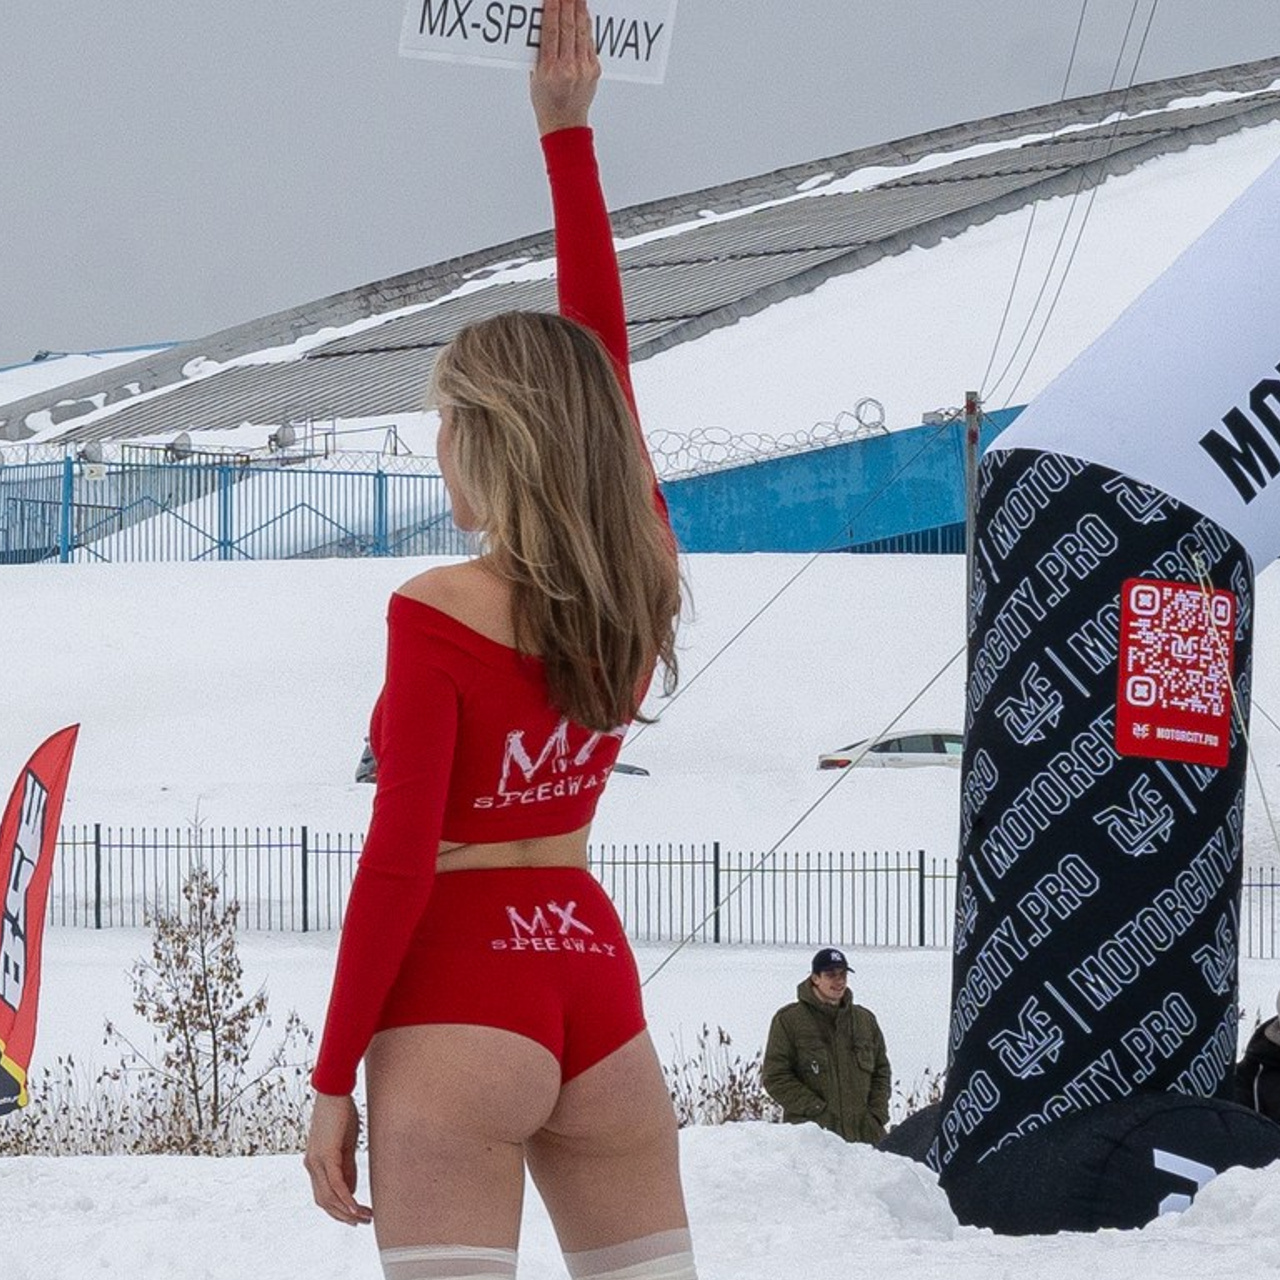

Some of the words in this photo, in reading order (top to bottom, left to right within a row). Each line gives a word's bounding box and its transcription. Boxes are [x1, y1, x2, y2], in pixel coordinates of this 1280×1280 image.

[1199, 363, 1280, 505] MO
[1156, 727, 1219, 747] MOTORCITY.PRO
[505, 900, 594, 939] MX
